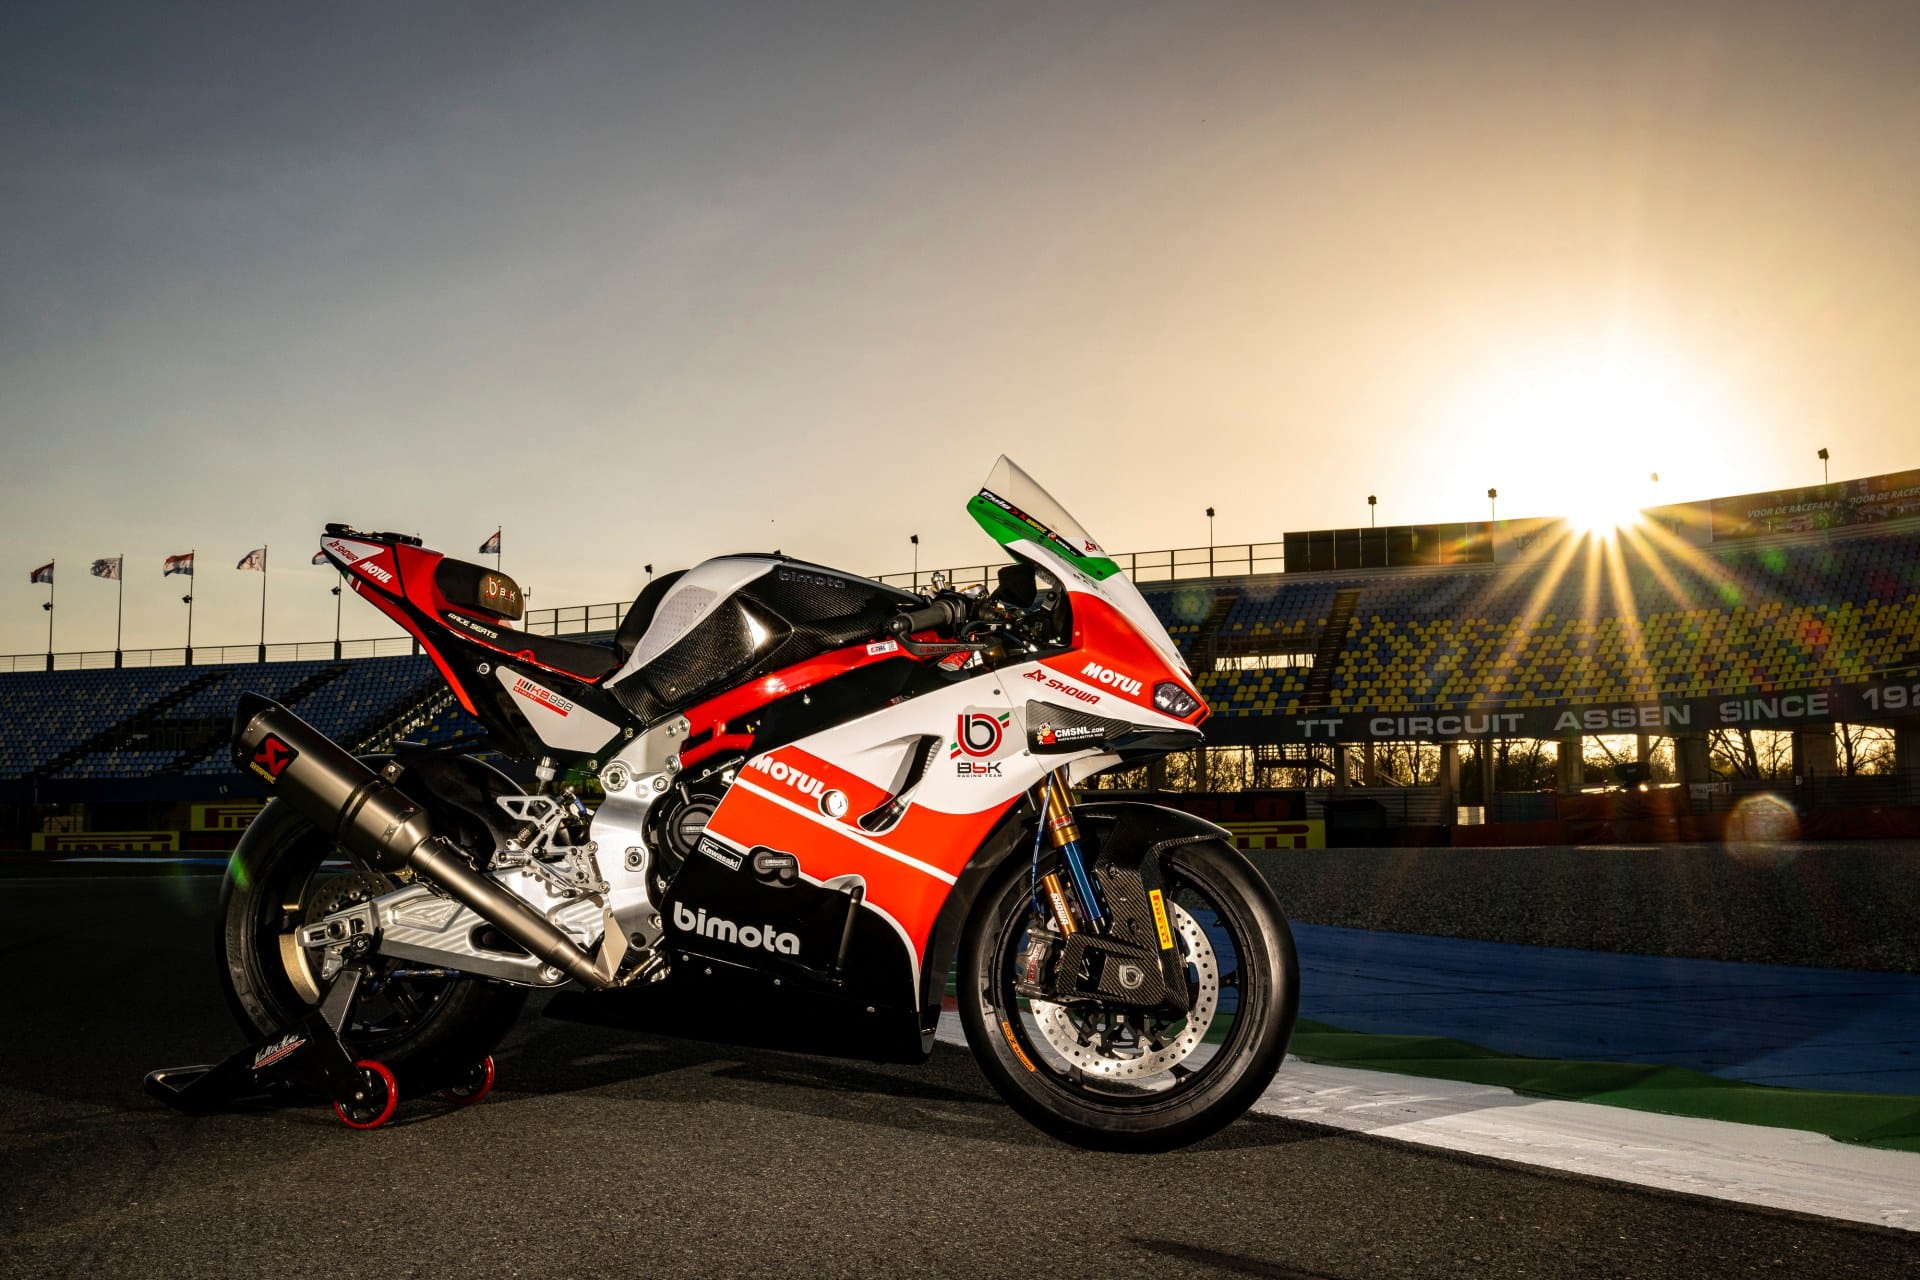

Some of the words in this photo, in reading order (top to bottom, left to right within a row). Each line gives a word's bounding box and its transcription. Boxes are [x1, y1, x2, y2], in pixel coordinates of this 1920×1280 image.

[1774, 506, 1788, 515] DE
[360, 561, 393, 584] MOTUL
[778, 569, 846, 589] bimota
[447, 612, 470, 627] RACE
[470, 623, 499, 639] SEATS
[1045, 679, 1101, 705] SHOWA
[1081, 662, 1143, 697] MOTUL
[1297, 719, 1344, 739] TT
[1369, 713, 1525, 737] CIRCUIT
[1554, 704, 1691, 731] ASSEN
[1719, 693, 1830, 723] SINCE
[748, 755, 825, 800] MOTUL
[701, 844, 739, 869] Kawasaki
[673, 901, 801, 956] bimota
